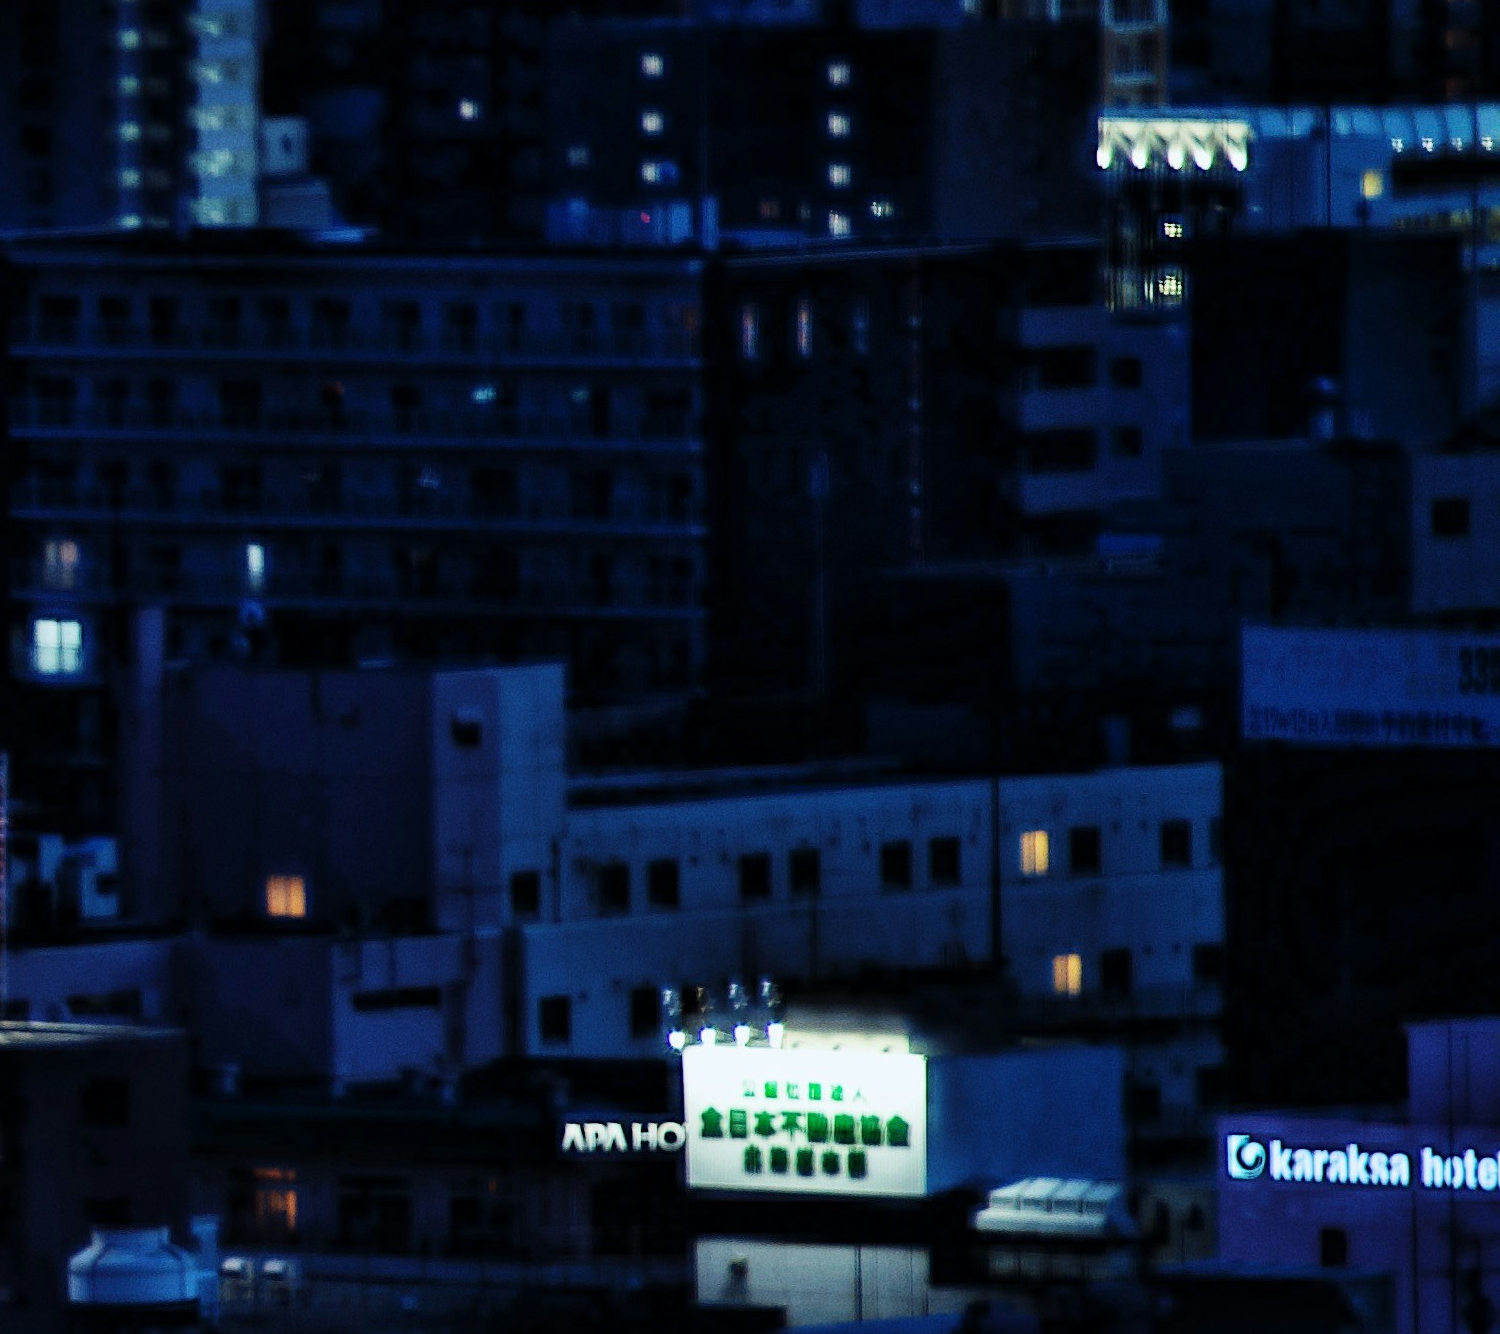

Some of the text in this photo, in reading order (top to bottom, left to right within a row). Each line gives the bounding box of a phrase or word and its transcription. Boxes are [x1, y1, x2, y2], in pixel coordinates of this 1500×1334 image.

[561, 1121, 687, 1153] APA HO
[1269, 1139, 1410, 1187] karaksa
